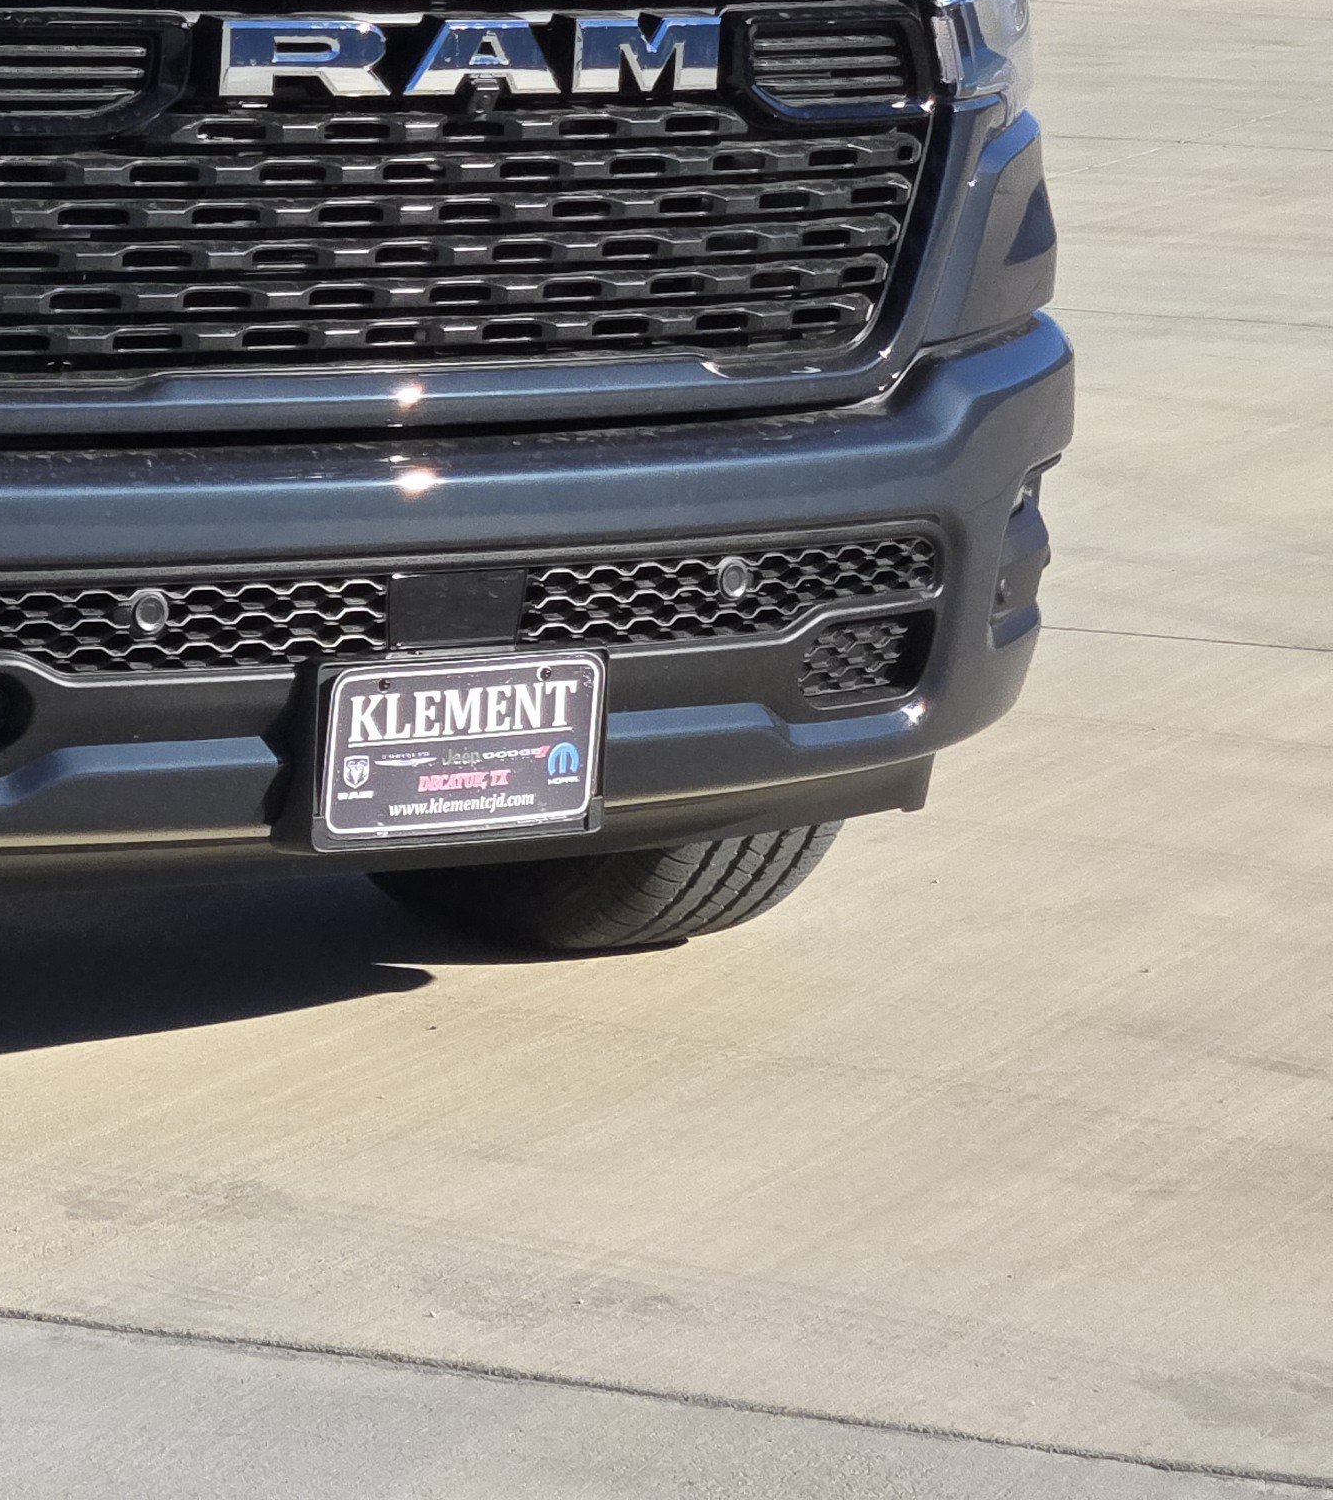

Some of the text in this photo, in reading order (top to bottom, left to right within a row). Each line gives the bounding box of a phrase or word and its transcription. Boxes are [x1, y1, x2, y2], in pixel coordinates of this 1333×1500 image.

[219, 16, 722, 97] RAM
[347, 679, 578, 743] KLEMENT
[441, 748, 483, 767] Jeep
[490, 769, 512, 787] TX
[388, 792, 535, 818] www.klementcjd.com
